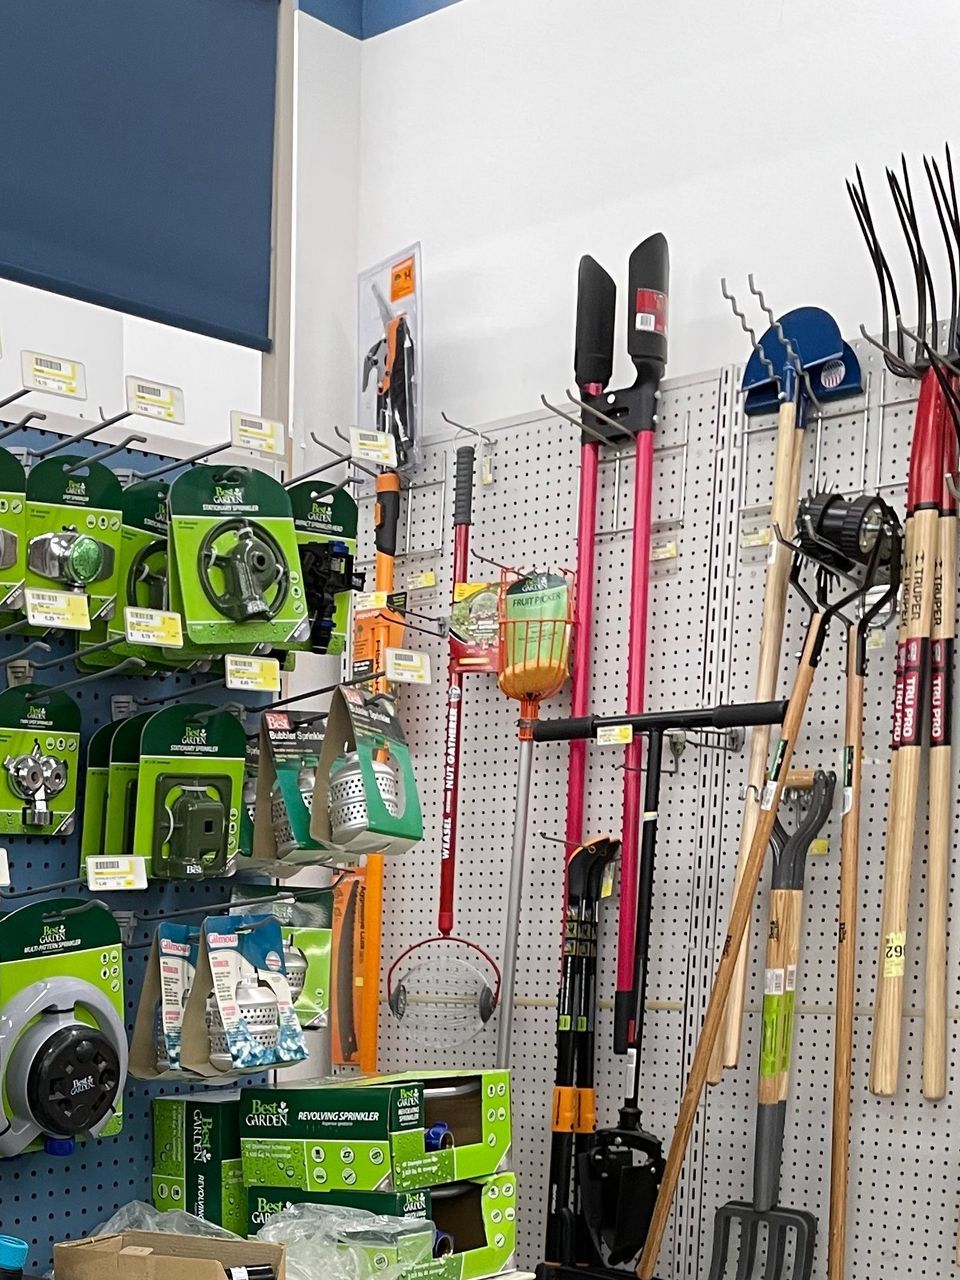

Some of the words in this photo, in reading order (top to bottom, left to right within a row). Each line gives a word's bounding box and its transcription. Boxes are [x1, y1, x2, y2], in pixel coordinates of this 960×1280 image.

[215, 487, 233, 498] Best
[213, 495, 244, 505] GARDEN
[308, 513, 332, 523] GARDEN
[911, 567, 924, 621] TRUPER
[934, 573, 943, 627] TRUPER
[512, 596, 532, 608] FRUIT
[905, 675, 916, 706] TRU
[932, 677, 942, 706] TRU
[902, 707, 914, 738] PRO
[931, 707, 942, 738] PRO
[269, 730, 297, 741] Bubbler
[445, 765, 454, 789] NUT
[43, 925, 59, 936] Best
[39, 933, 66, 944] GARDEN
[252, 1100, 278, 1114] Best
[397, 1096, 419, 1108] GARDEN
[245, 1113, 288, 1127] GARDEN
[298, 1111, 340, 1121] REVOLVING
[339, 1111, 380, 1122] SPRINKLER
[193, 1109, 203, 1162] GARDEN
[202, 1117, 213, 1150] Best
[257, 1197, 283, 1213] Best
[403, 1202, 425, 1212] GARDEN
